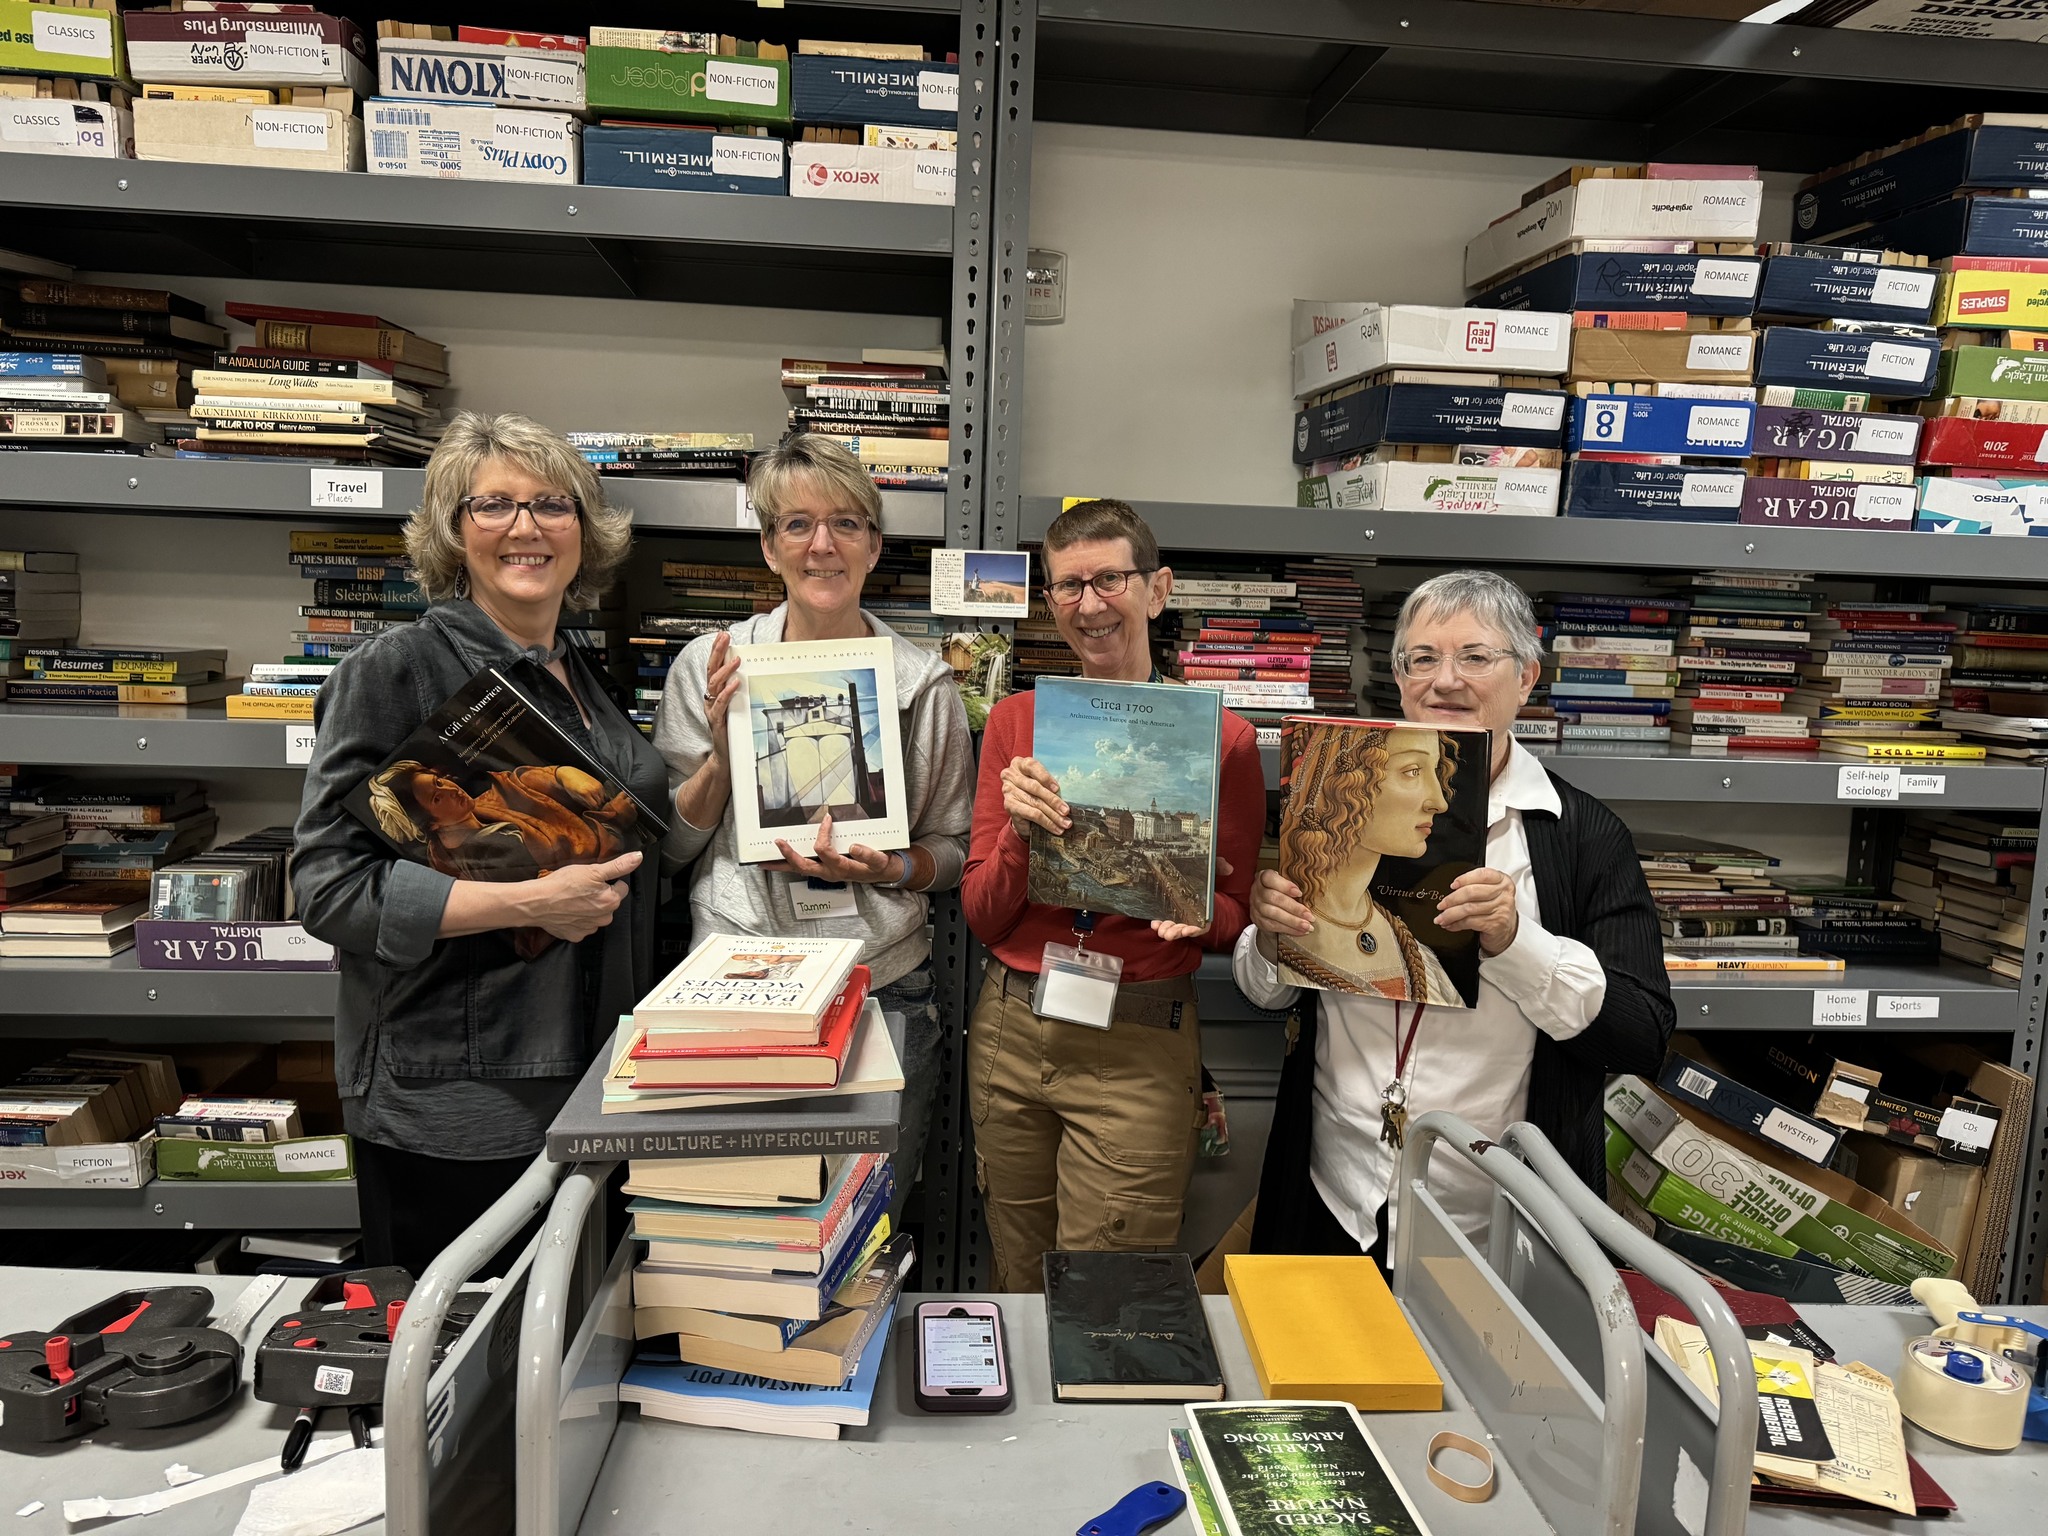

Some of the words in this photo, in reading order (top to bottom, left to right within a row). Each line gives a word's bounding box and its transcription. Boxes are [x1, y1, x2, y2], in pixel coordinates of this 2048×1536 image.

[1911, 3, 2046, 21] DEPOT
[47, 25, 95, 40] CLASSICS
[183, 19, 218, 35] Plus
[220, 17, 325, 36] Williamsburg
[250, 43, 320, 58] NON-FICTION
[191, 55, 223, 65] PAPER
[507, 69, 574, 86] NON-FICTION
[709, 73, 776, 90] NON-FICTION
[13, 114, 60, 127] CLASSICS
[255, 121, 325, 135] NON-FICTION
[496, 124, 563, 140] NON-FICTION
[484, 146, 519, 168] Plus
[716, 149, 780, 163] NON-FICTION
[378, 161, 407, 170] 10540-0
[440, 161, 461, 171] 5000
[520, 153, 568, 176] Copy
[833, 171, 879, 185] xerox
[1703, 195, 1747, 208] ROMANCE
[1704, 271, 1749, 283] ROMANCE
[1887, 281, 1920, 293] FICTION
[1959, 296, 2007, 310] STAPLES
[1470, 328, 1490, 337] RED
[1504, 324, 1549, 337] ROMANCE
[1471, 336, 1489, 345] TRU
[1697, 346, 1742, 357] ROMANCE
[218, 356, 227, 365] THE
[283, 359, 310, 372] GUIDE
[1881, 353, 1915, 366] FICTION
[268, 376, 291, 388] Long
[293, 377, 319, 388] Walks
[2004, 370, 2033, 383] Eagle
[194, 407, 258, 418] KAUNEIMMAT
[1511, 403, 1555, 416] ROMANCE
[1595, 403, 1619, 411] REAMS
[216, 419, 242, 429] PILLAR
[243, 421, 253, 430] TO
[255, 421, 275, 431] POST
[818, 422, 862, 434] NIGERIA
[1595, 411, 1615, 438] 8
[1697, 416, 1741, 428] ROMANCE
[1871, 429, 1904, 440] FICTION
[573, 435, 604, 448] Living
[606, 435, 625, 447] with
[627, 435, 644, 446] Art
[606, 462, 635, 470] SUZHOU
[875, 464, 907, 474] MOVIE
[911, 466, 940, 475] STARS
[327, 481, 367, 494] Travel
[1504, 482, 1549, 495] ROMANCE
[1690, 483, 1735, 496] ROMANCE
[1810, 485, 1857, 498] DIGITAL
[328, 493, 353, 504] Places
[1869, 495, 1903, 506] FICTION
[1972, 494, 2019, 504] VERSO.
[334, 537, 359, 545] Calculus
[291, 554, 323, 565] JAMES
[325, 555, 358, 566] BURKE
[356, 566, 385, 580] CISSP
[350, 583, 373, 591] THE
[335, 588, 420, 604] Sleepwalkers
[304, 608, 330, 617] LOOKING
[331, 609, 348, 618] GOOD
[356, 611, 375, 619] PRINT
[354, 619, 380, 633] Digital
[1561, 622, 1584, 631] TOTAL
[1587, 623, 1617, 632] RECALL
[28, 648, 60, 657] resonate
[52, 659, 104, 671] Resumes
[1579, 672, 1604, 681] panic
[1863, 669, 1899, 677] WONDER
[1908, 669, 1927, 677] BOYS
[11, 687, 38, 696] Business
[40, 687, 71, 697] Statistics
[82, 688, 117, 698] Practice
[250, 687, 279, 696] EVENT
[1228, 684, 1251, 693] THAYNE
[1091, 698, 1121, 712] Circa
[1126, 702, 1154, 714] 1700
[438, 735, 448, 744] A
[444, 721, 463, 737] Gift
[461, 713, 472, 723] to
[469, 685, 503, 715] America
[1070, 712, 1101, 721] Architecture
[1696, 715, 1713, 724] Why
[1738, 716, 1760, 724] Works
[1854, 709, 1884, 717] WISDOM
[1900, 710, 1914, 718] EGO
[1834, 719, 1860, 727] mindset
[1571, 727, 1615, 737] RECOVERY
[1846, 771, 1890, 782] Self-help
[1907, 777, 1938, 789] Family
[1845, 786, 1892, 798] Sociology
[1377, 885, 1414, 898] Virtue
[1416, 888, 1428, 899] &
[797, 901, 831, 911] Tammi
[1844, 920, 1861, 928] TOTAL
[210, 926, 262, 938] DIGITAL
[288, 935, 306, 946] CDs
[1716, 960, 1746, 970] HEAVY
[1746, 962, 1788, 970] EQUIPMENT
[682, 979, 805, 989] VACCINES
[665, 991, 798, 1002] PARENT
[1827, 994, 1857, 1005] Home
[1889, 1000, 1922, 1012] Sports
[1821, 1011, 1862, 1023] Hobbies
[1874, 1098, 1908, 1113] LIMITED
[1644, 1108, 1663, 1128] MYSTERY
[1777, 1120, 1819, 1147] MYSTERY
[1963, 1122, 1978, 1133] CDs
[568, 1137, 635, 1155] JAPAN!
[643, 1135, 723, 1152] CULTURE
[741, 1130, 880, 1149] HYPERCULTURE
[285, 1149, 335, 1162] ROMANCE
[73, 1158, 112, 1168] FICTION
[1631, 1160, 1650, 1183] MYSTERY
[686, 1368, 723, 1384] POT
[729, 1373, 812, 1392] INSTANT
[1758, 1396, 1787, 1446] WONDERFUL
[1774, 1397, 1803, 1443] REVEREND
[1224, 1431, 1345, 1443] ARMSTRONG
[1256, 1442, 1326, 1454] KAREN
[1258, 1464, 1291, 1472] World
[1295, 1463, 1338, 1471] Natural
[1263, 1472, 1287, 1480] with
[1291, 1471, 1319, 1479] Bond
[1266, 1480, 1289, 1488] Our
[1291, 1478, 1346, 1487] Restoring
[1883, 1490, 1897, 1501] 21
[1265, 1497, 1368, 1511] NATURE
[1274, 1511, 1372, 1526] SACRED
